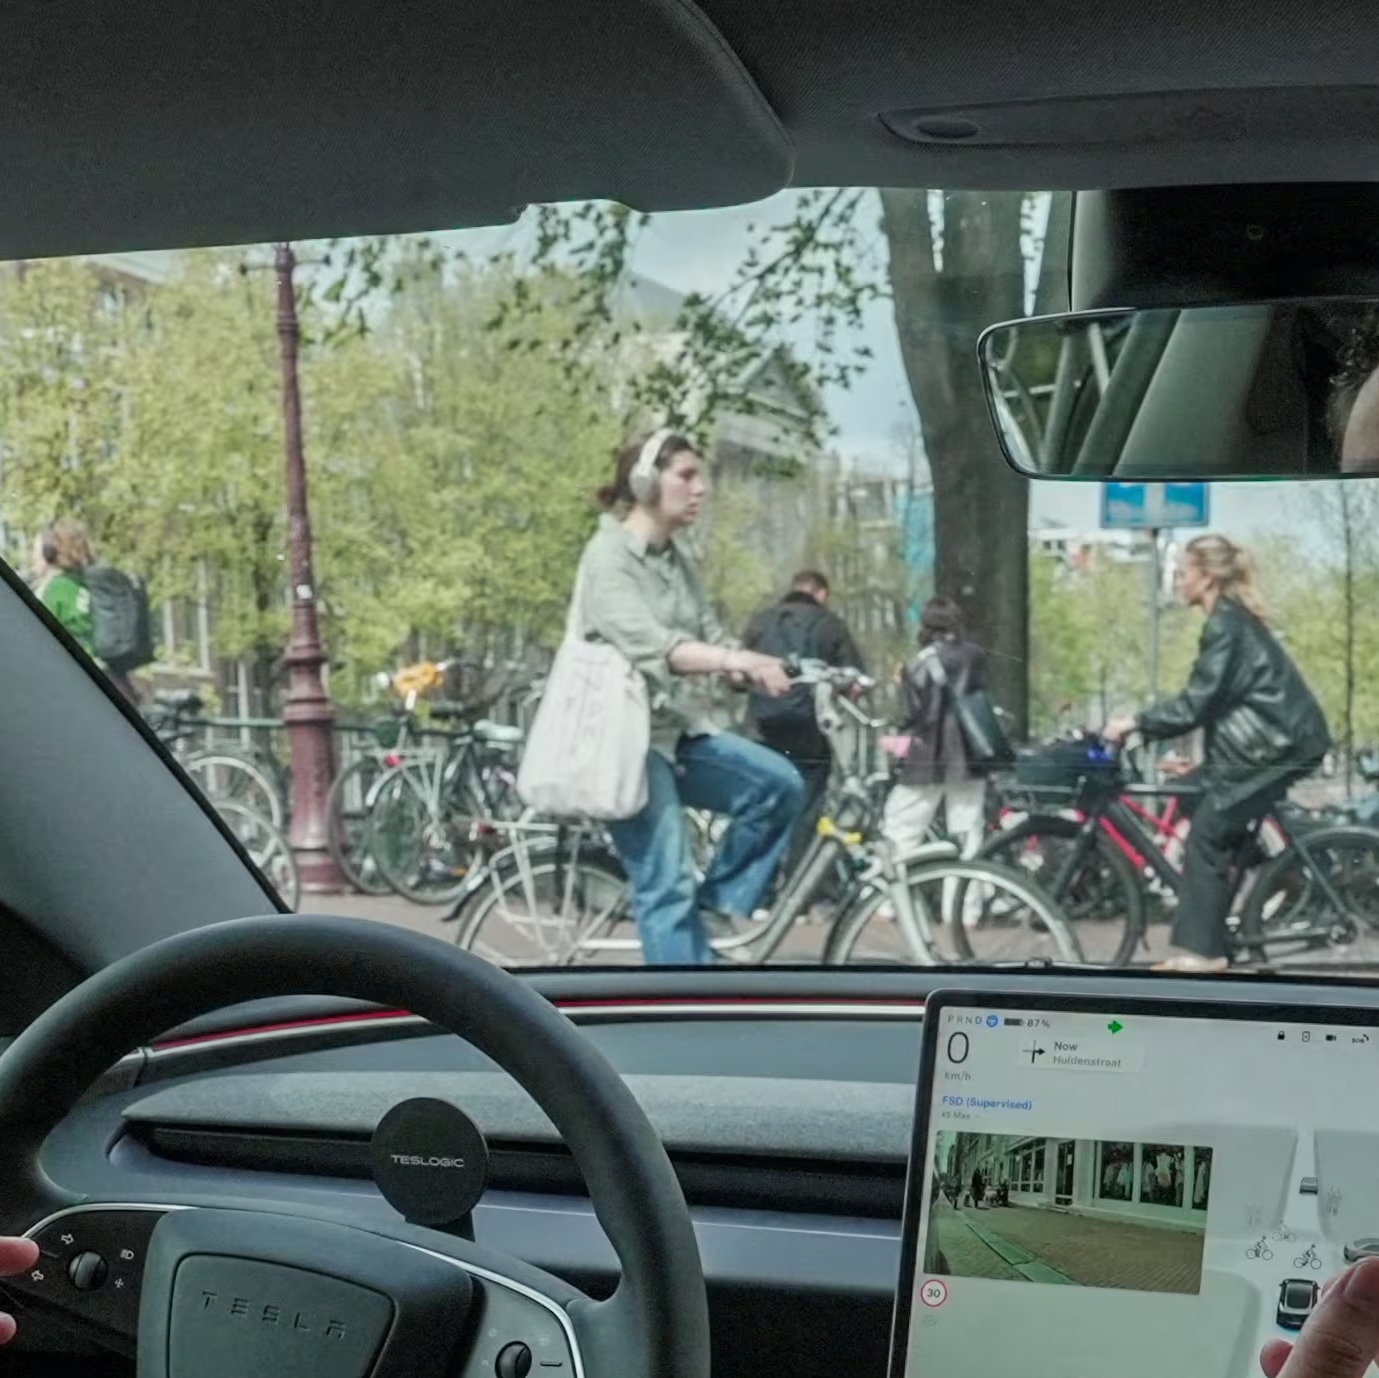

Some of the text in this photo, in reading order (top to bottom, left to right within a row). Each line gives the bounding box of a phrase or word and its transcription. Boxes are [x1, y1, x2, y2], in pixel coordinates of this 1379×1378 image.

[1027, 1018, 1051, 1028] 87%
[947, 1031, 969, 1064] 0
[1054, 1041, 1078, 1052] Now
[944, 1071, 972, 1082] km/h
[942, 1095, 1033, 1112] FSD (Supervised)
[389, 1152, 465, 1170] TESLOGIC
[927, 1288, 941, 1298] 30
[201, 1288, 347, 1341] TESLA
